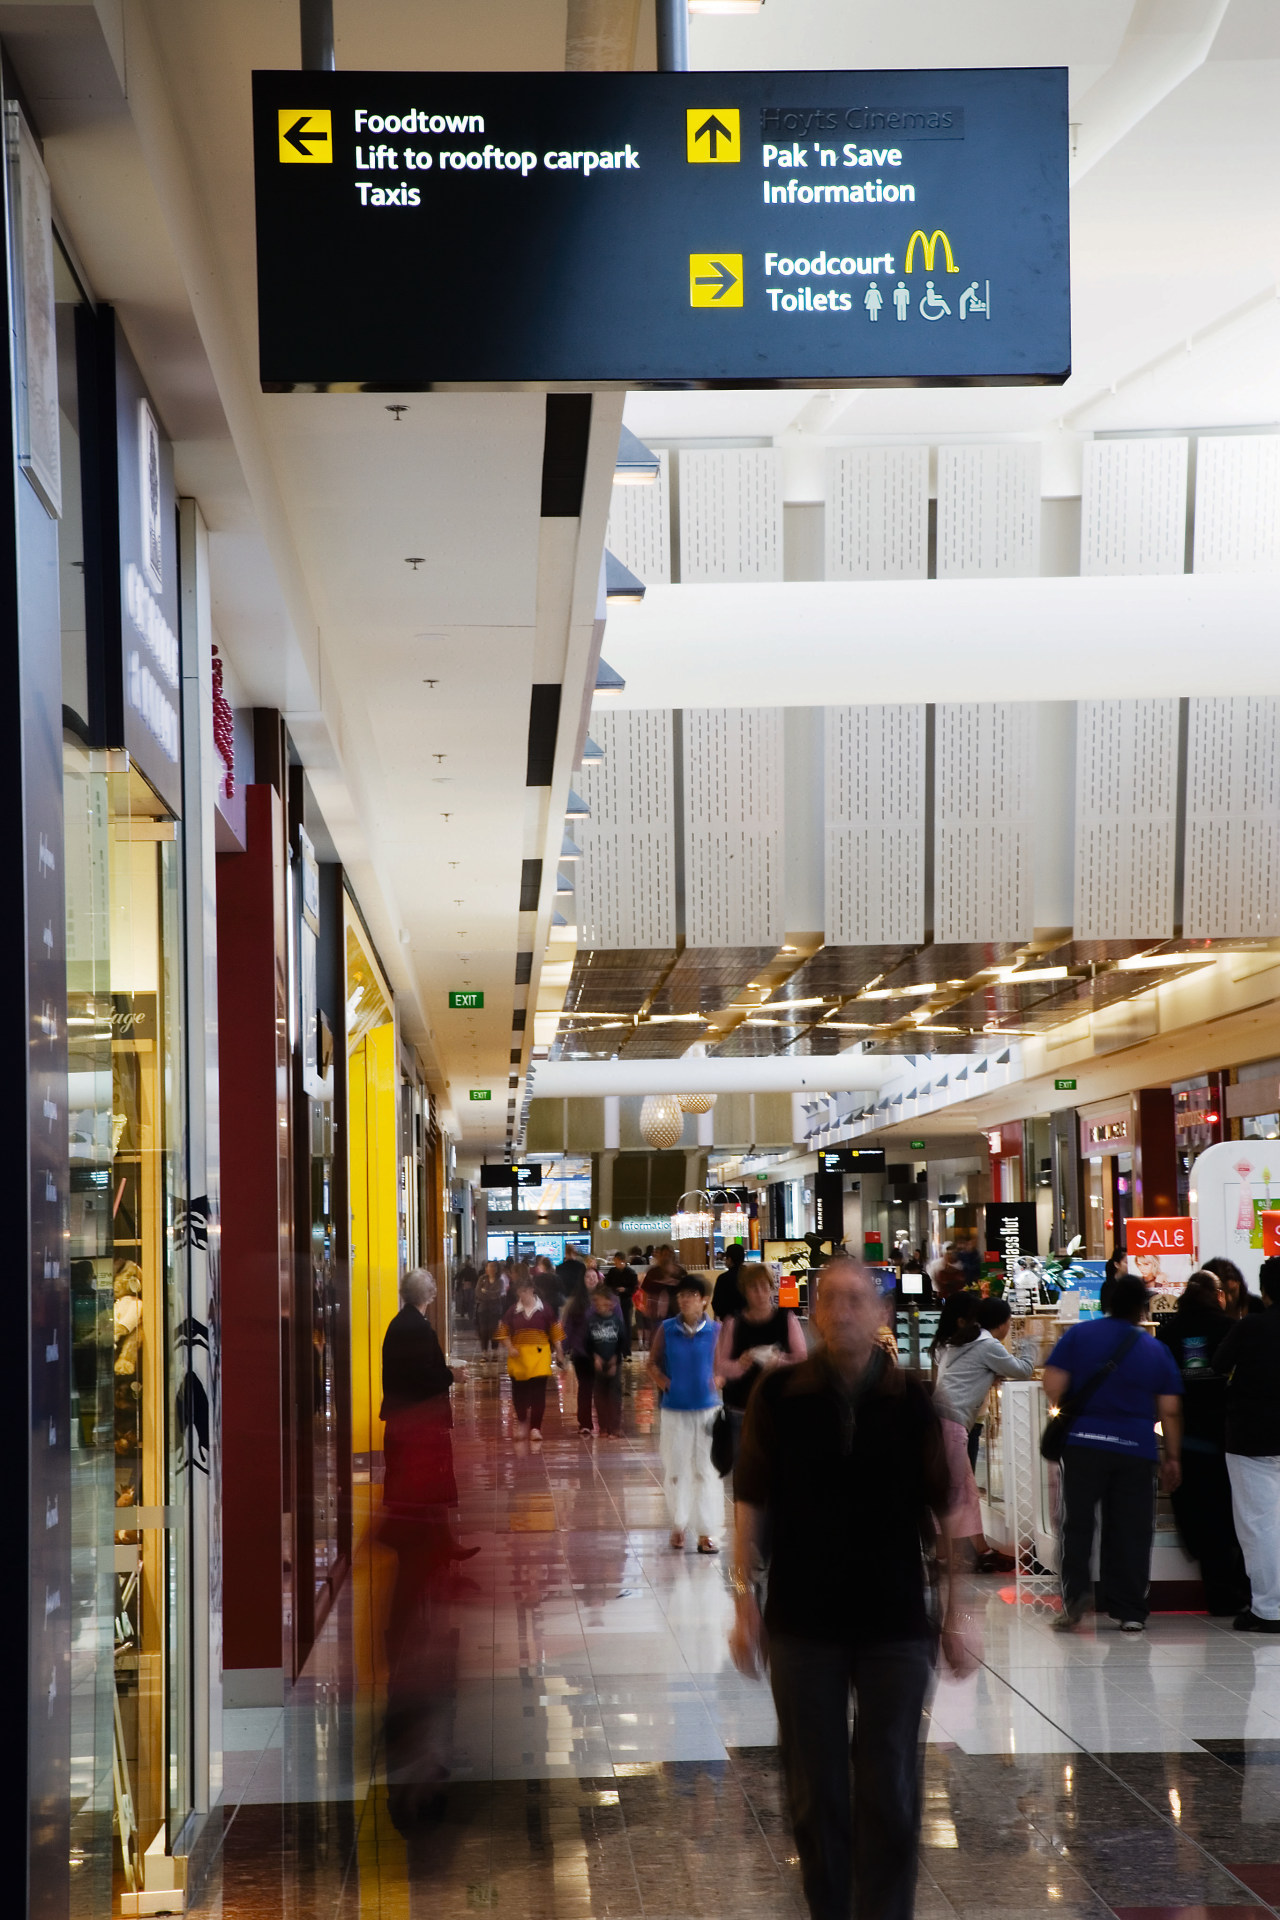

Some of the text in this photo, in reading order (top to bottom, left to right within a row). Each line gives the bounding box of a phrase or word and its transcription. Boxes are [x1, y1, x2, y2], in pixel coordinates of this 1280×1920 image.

[354, 108, 485, 133] Foodtown
[762, 107, 953, 136] Hoyts Cinemas
[355, 144, 640, 176] Lift to rooftop carpark
[762, 143, 903, 167] Pak 'n Save
[355, 182, 421, 206] Taxis
[762, 178, 915, 204] Information
[764, 250, 895, 276] Foodcourt
[766, 286, 852, 312] Toilets
[455, 994, 478, 1006] EXIT
[473, 1091, 488, 1099] EXIT
[1058, 1081, 1073, 1089] EXIT
[999, 1216, 1019, 1235] Hut
[1135, 1229, 1185, 1248] SALE
